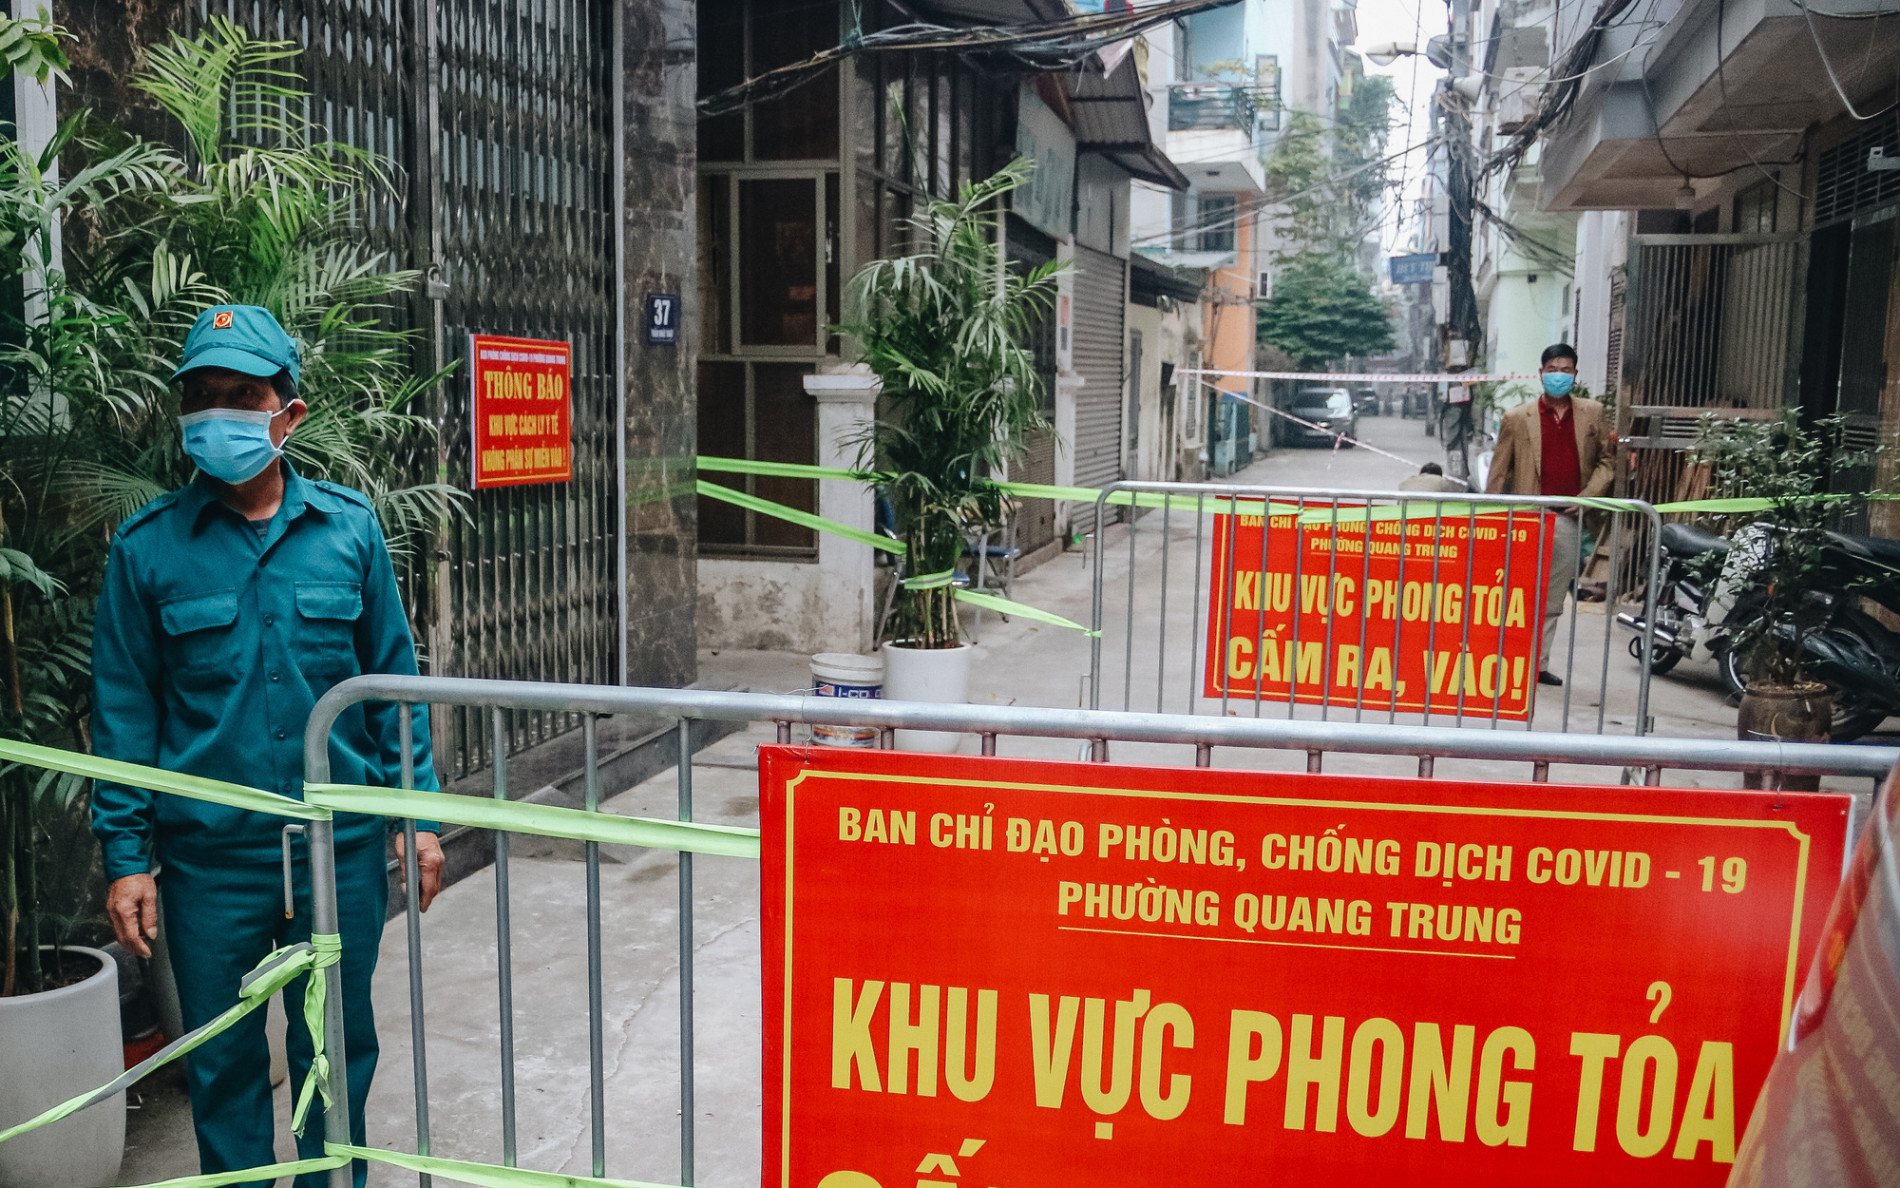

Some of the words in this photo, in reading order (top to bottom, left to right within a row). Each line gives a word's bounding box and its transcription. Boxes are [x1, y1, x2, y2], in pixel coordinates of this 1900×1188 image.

[654, 299, 671, 326] 37
[483, 365, 532, 399] THÔNG
[537, 367, 564, 400] BÁO
[489, 415, 503, 436] KHU
[504, 412, 518, 441] VỰC
[519, 410, 536, 436] CÁCH
[1235, 570, 1292, 612] KHU
[1301, 572, 1355, 624] VỰC
[1365, 579, 1463, 624] PHONG
[1472, 568, 1525, 628] TỎA
[1228, 624, 1323, 684] CẤM
[1336, 643, 1406, 697] RA,
[1423, 642, 1525, 700] VÀO!
[838, 806, 917, 846] BAN
[929, 802, 995, 851] CHỈ
[1005, 817, 1085, 863] ĐẠO
[1098, 818, 1247, 872] PHÒNG,
[1261, 823, 1401, 877] CHỐNG
[1414, 841, 1513, 887] DỊCH
[1526, 846, 1651, 889] COVID
[1697, 855, 1748, 894] 19
[1058, 876, 1220, 926] PHƯỜNG
[1233, 894, 1372, 937] QUANG
[1386, 902, 1522, 945] TRUNG
[831, 976, 998, 1103] KHU
[1028, 988, 1195, 1140] VỰC
[1223, 1008, 1536, 1148] PHONG
[1569, 980, 1737, 1164] TỎA
